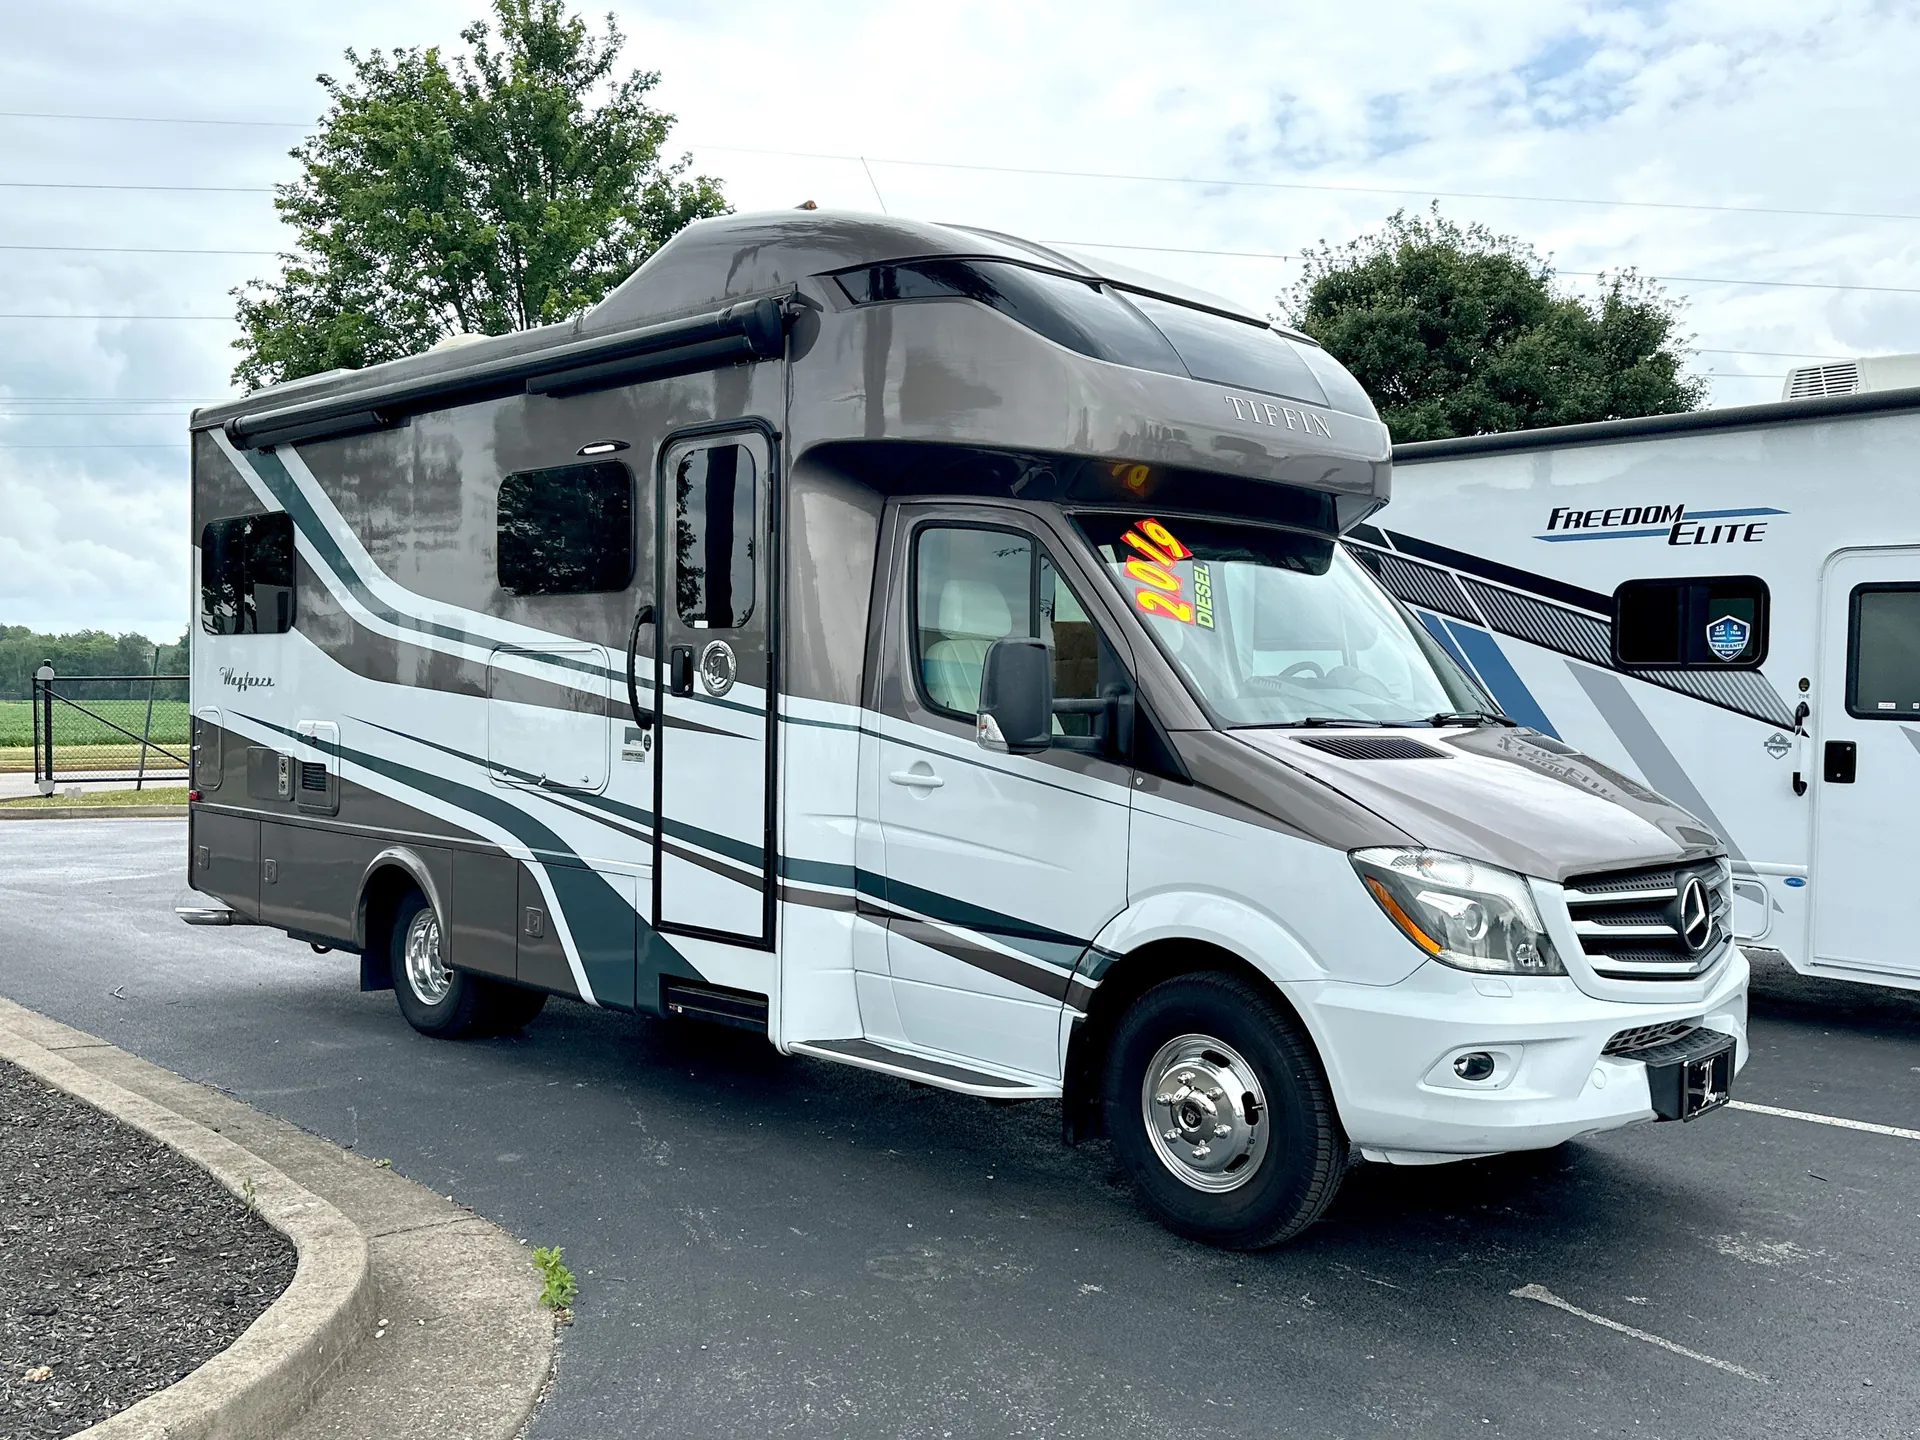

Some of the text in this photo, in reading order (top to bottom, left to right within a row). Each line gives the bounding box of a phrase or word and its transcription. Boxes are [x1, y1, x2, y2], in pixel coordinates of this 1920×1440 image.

[1224, 395, 1332, 439] TIFFIN
[1546, 504, 1768, 546] FREEDOM ELITE
[1123, 518, 1194, 623] 2019
[1193, 563, 1214, 629] DIESEL
[218, 665, 275, 693] Wayfarer
